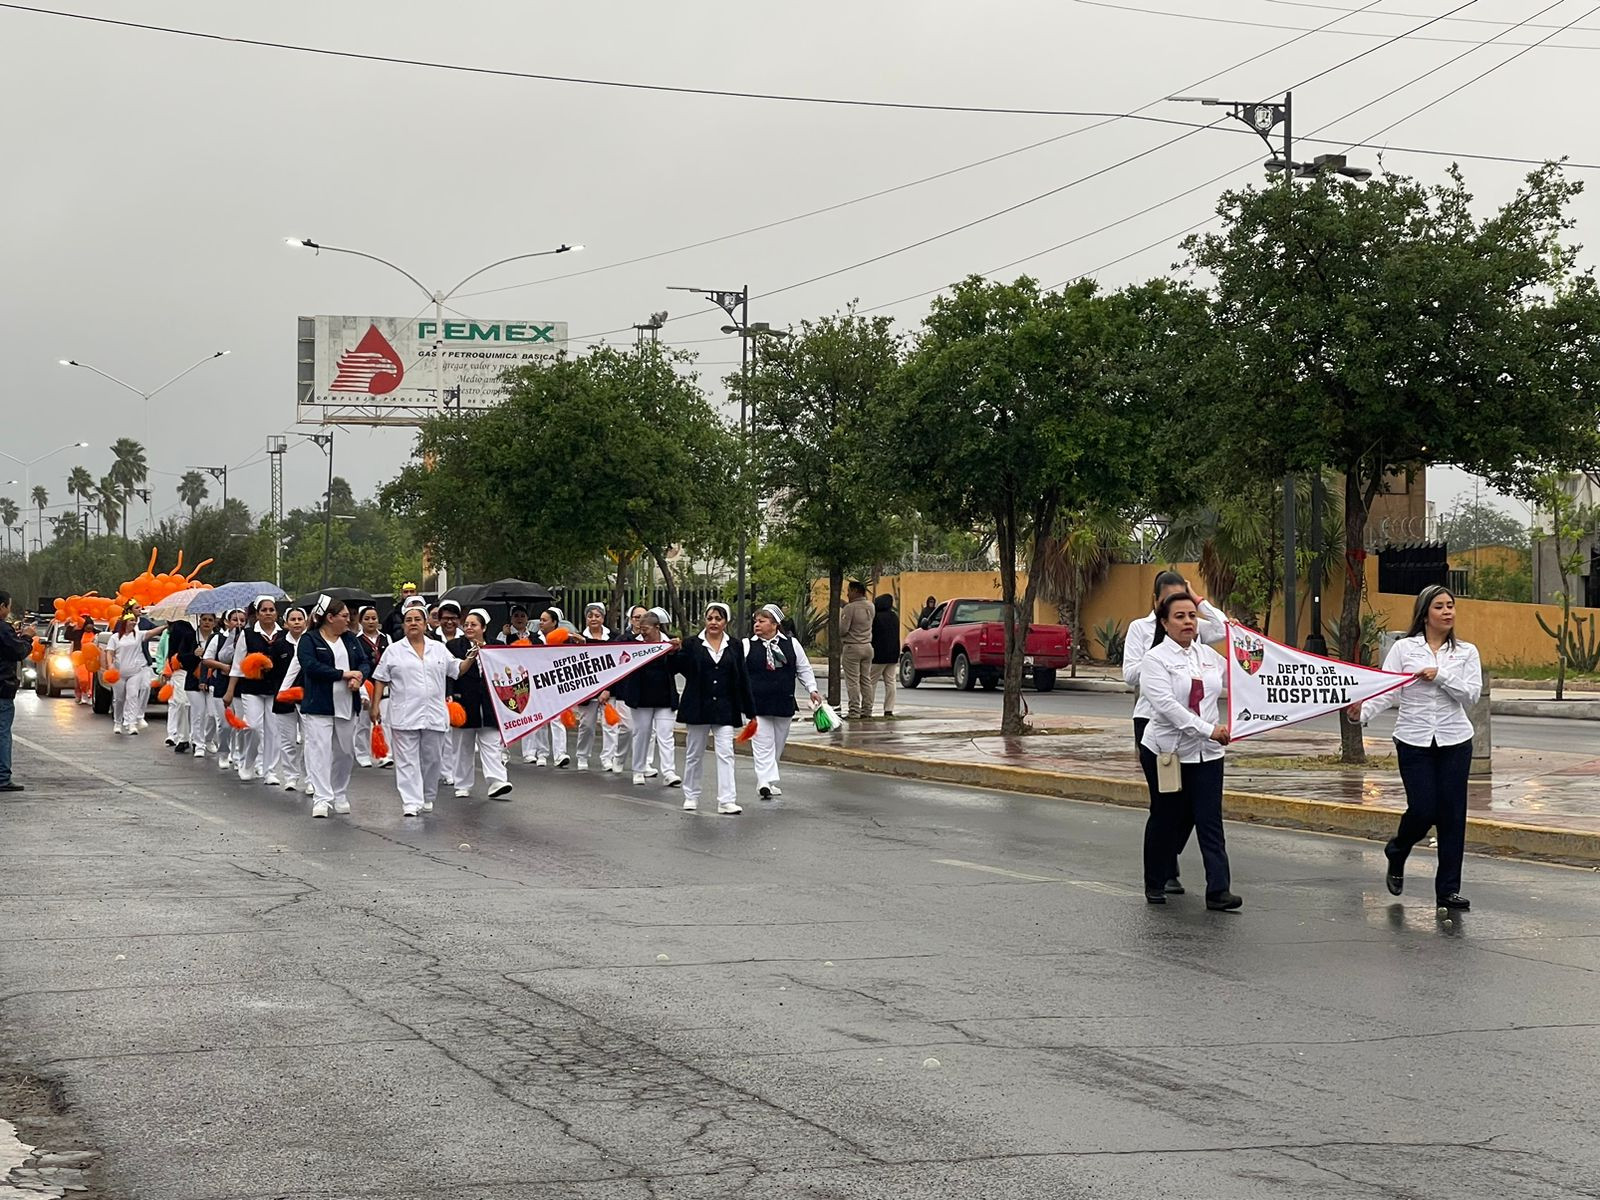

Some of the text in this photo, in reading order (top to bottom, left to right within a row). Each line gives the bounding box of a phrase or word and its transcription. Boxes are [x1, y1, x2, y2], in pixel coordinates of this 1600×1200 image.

[418, 322, 555, 342] PEMEX
[418, 350, 437, 358] GAS
[448, 351, 518, 360] PETROQUIMICA
[521, 353, 556, 361] BASICA
[442, 362, 468, 372] gregar
[580, 651, 590, 661] DE
[631, 644, 664, 660] PEMEX
[532, 653, 617, 690] ENFERMERIA
[1278, 663, 1337, 676] DEPTO. DE
[557, 674, 600, 695] HOSPITAL
[1258, 674, 1359, 687] TRABAJO SOCIAL
[1267, 688, 1351, 704] HOSPITAL
